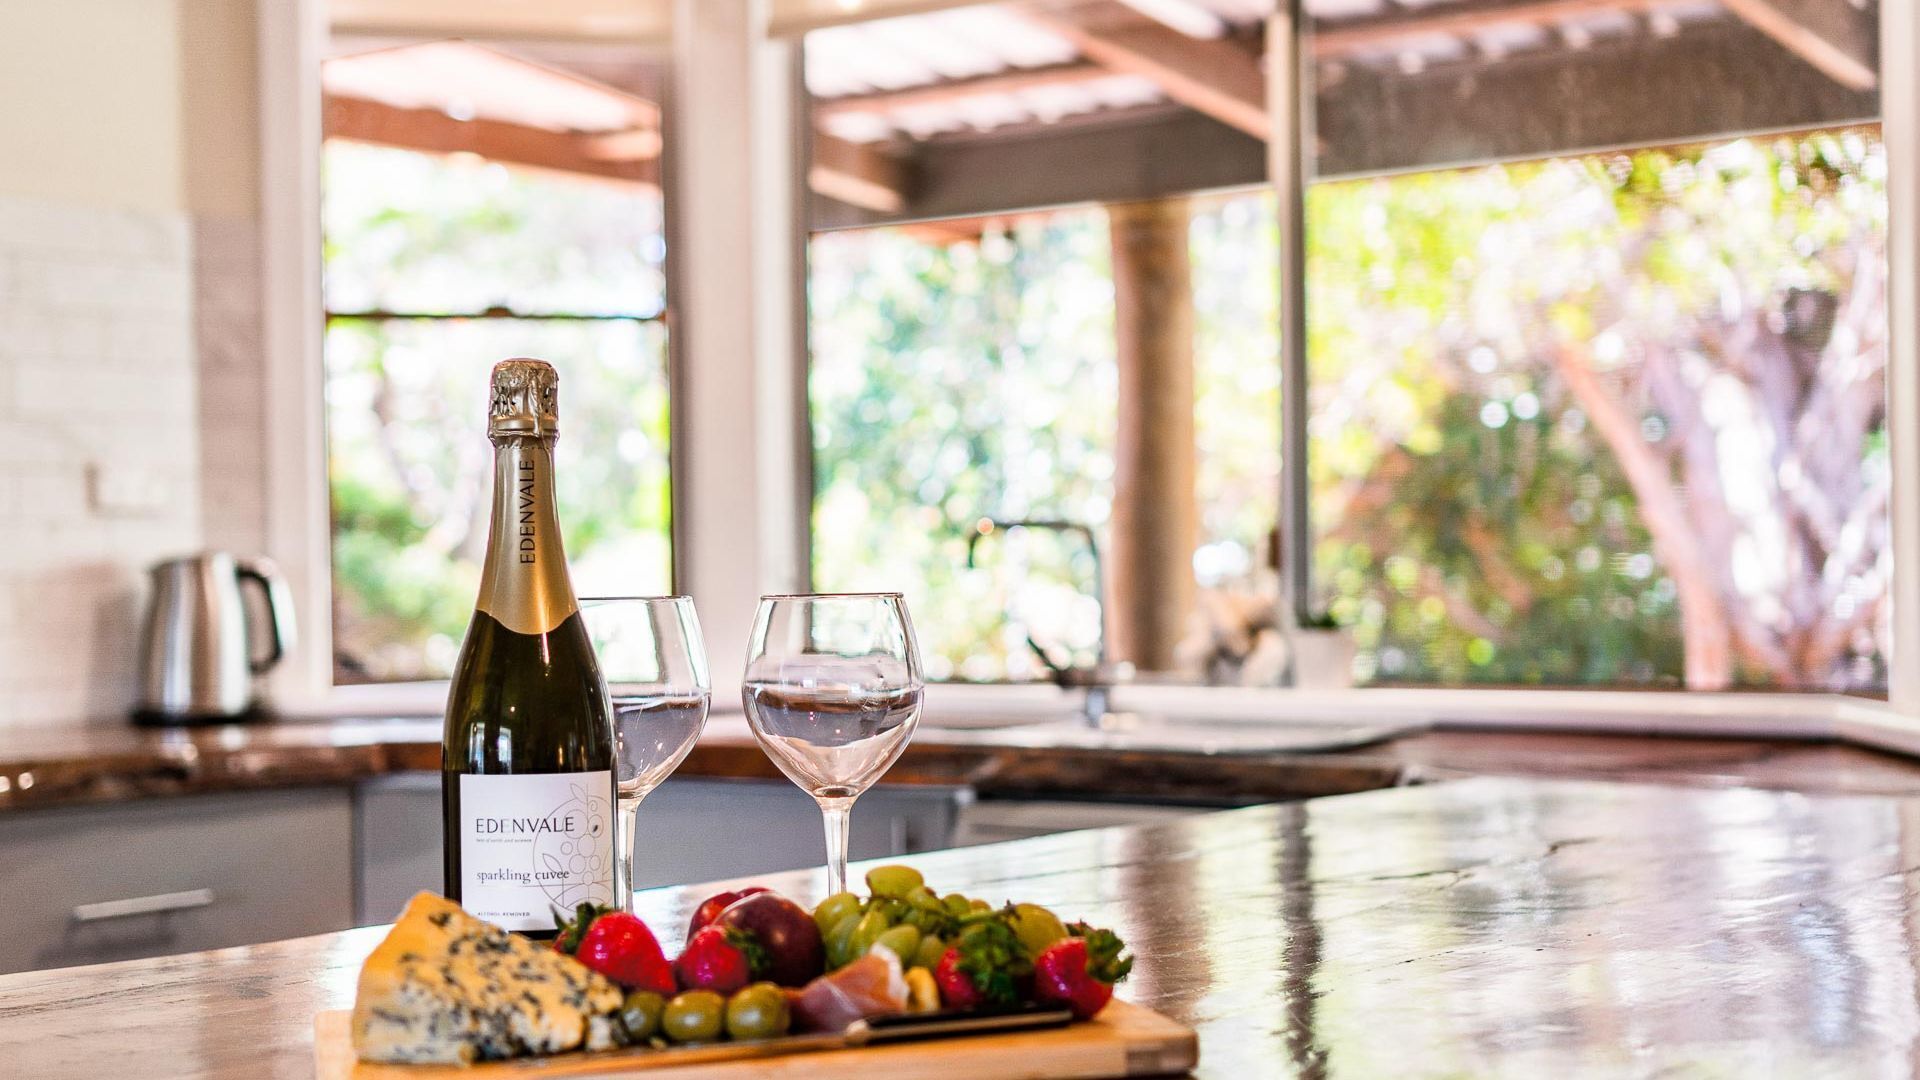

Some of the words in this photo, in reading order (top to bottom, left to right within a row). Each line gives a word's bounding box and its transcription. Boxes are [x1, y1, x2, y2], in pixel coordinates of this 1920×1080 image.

[520, 460, 536, 564] EDENVALE
[476, 816, 575, 834] EDENVALE
[476, 868, 532, 885] sparkling
